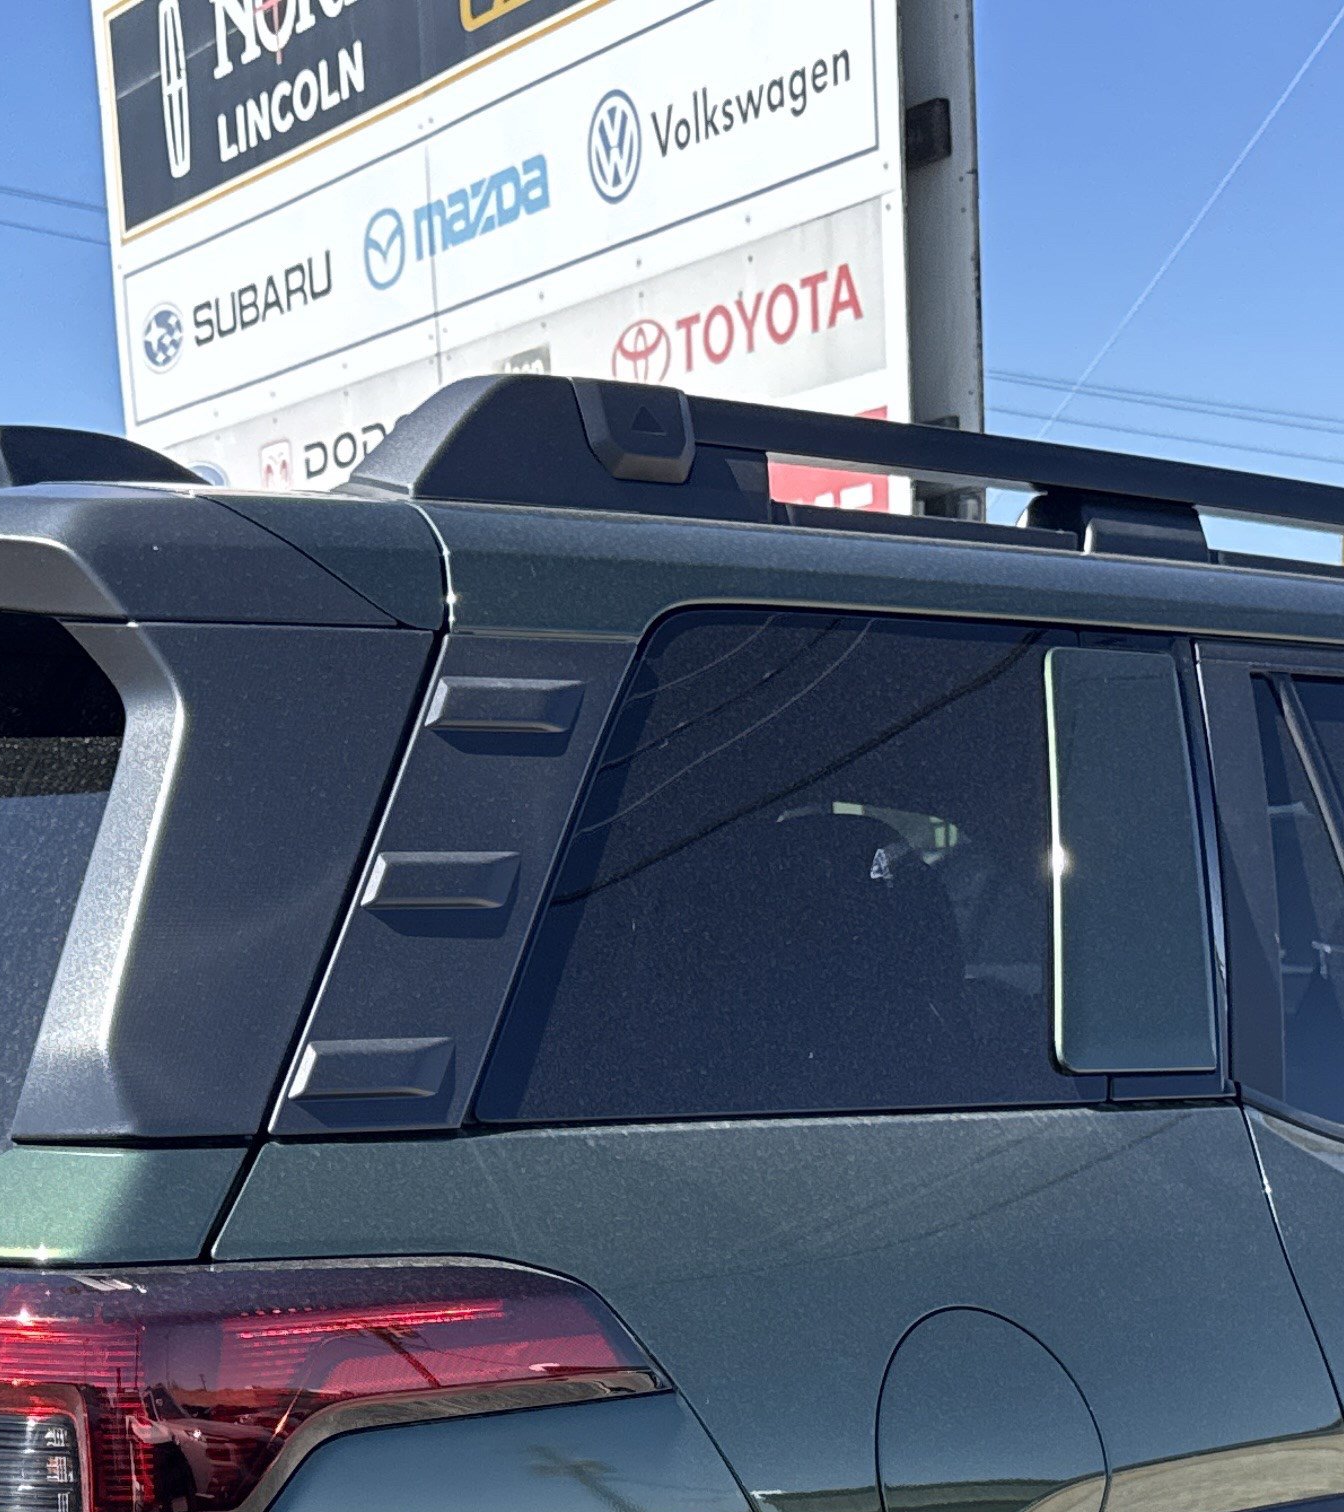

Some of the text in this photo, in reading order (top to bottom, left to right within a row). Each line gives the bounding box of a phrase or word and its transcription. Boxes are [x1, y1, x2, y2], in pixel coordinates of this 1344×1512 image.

[217, 40, 365, 162] LINCOLN
[650, 48, 852, 158] Volkswagen
[413, 153, 552, 263] mazda
[192, 249, 333, 347] SUBARU
[675, 262, 864, 373] TOYOTA
